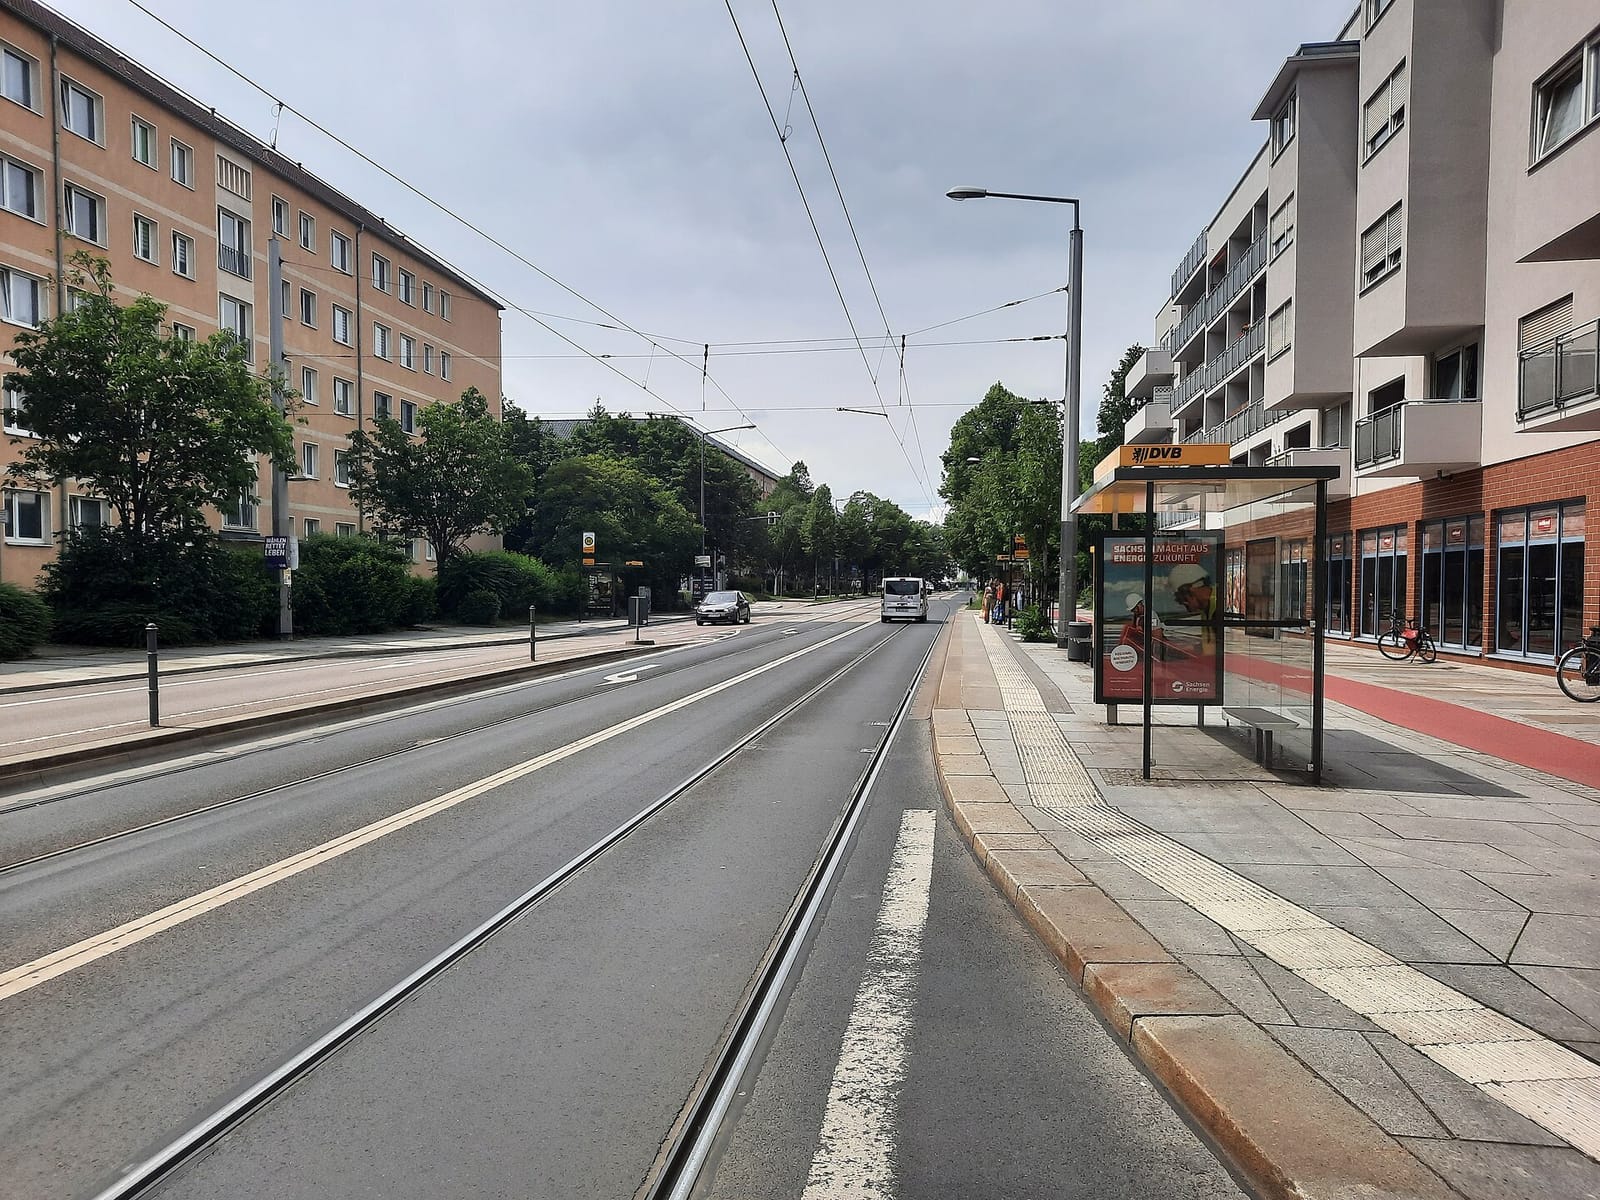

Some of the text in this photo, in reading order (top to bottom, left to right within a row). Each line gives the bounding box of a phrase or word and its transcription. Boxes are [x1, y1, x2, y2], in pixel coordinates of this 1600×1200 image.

[1149, 447, 1182, 458] DVB
[1114, 544, 1209, 553] SACHS MACHT AUS
[1114, 554, 1197, 562] ENERGI ZUKUNFT.
